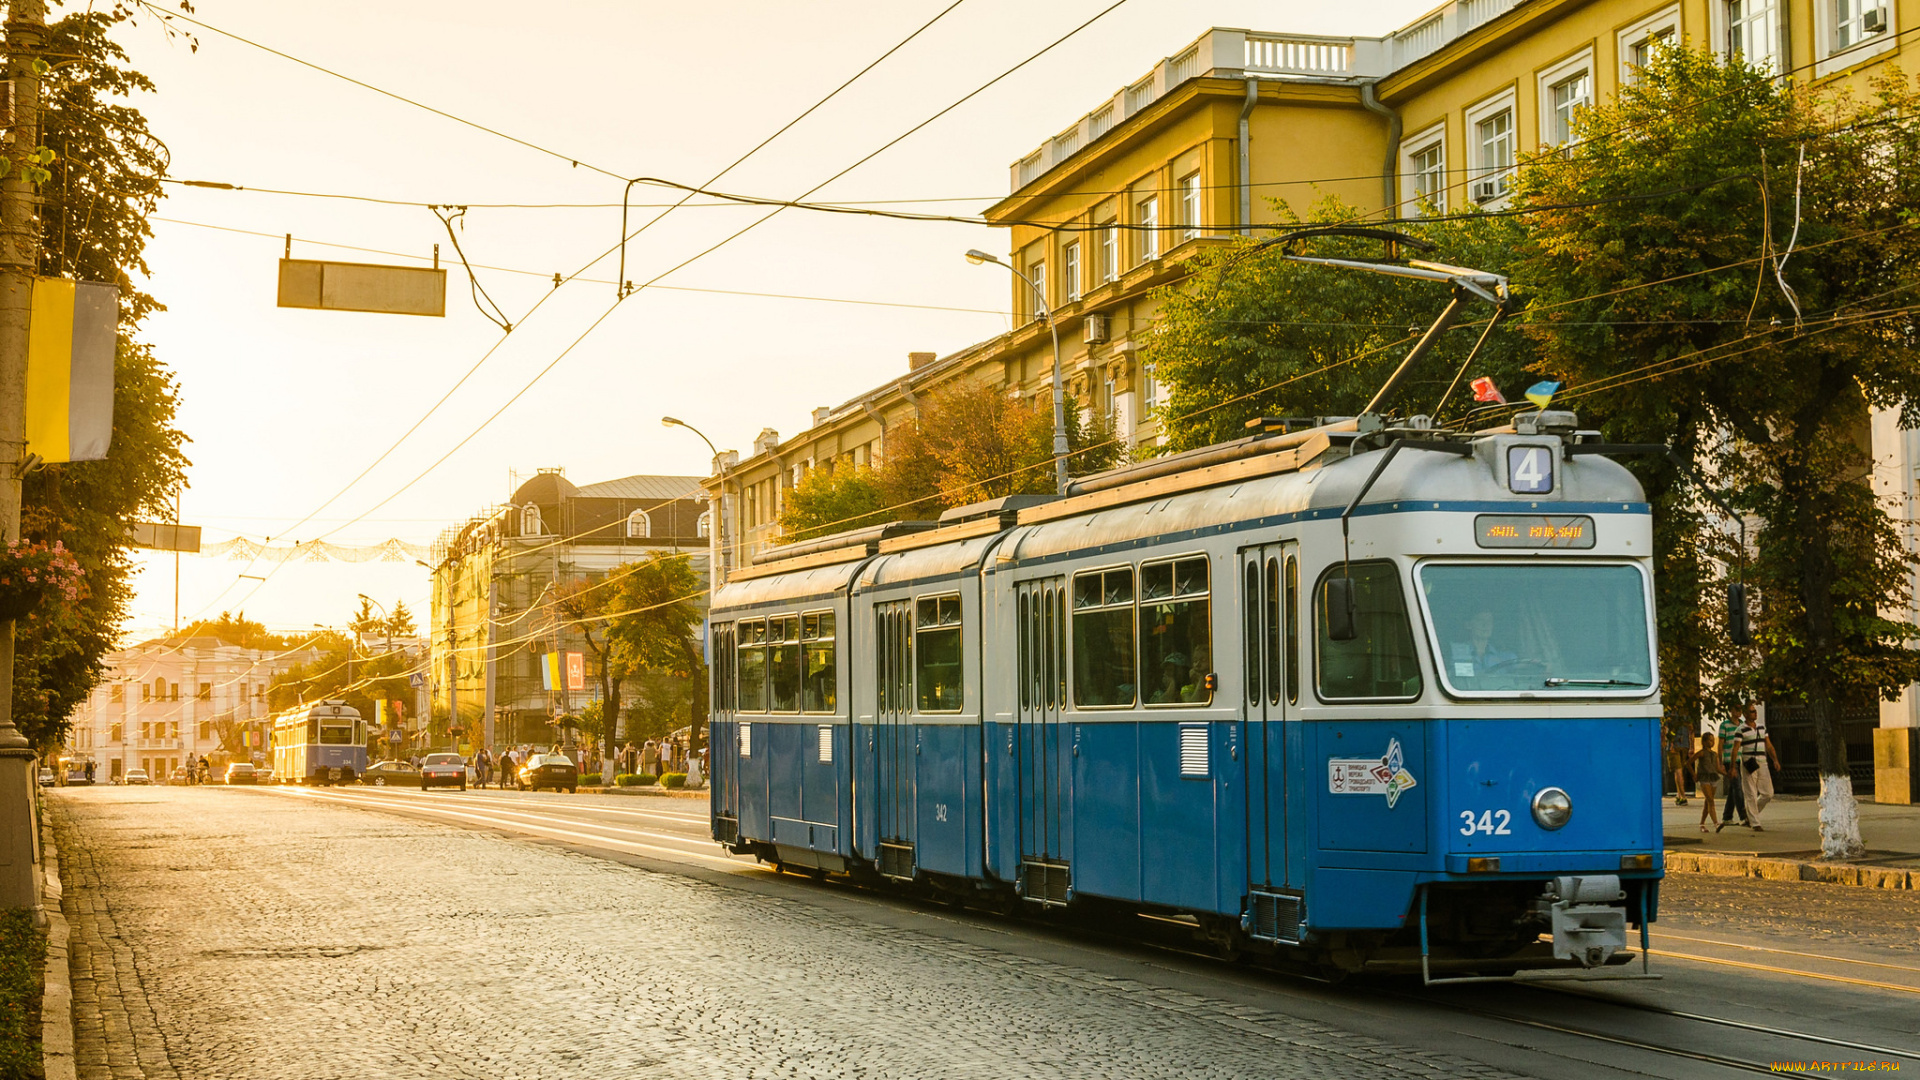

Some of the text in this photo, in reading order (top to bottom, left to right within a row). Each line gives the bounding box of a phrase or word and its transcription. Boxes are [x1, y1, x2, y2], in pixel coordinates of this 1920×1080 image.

[1514, 447, 1543, 489] 4
[935, 803, 947, 822] 342
[1460, 809, 1512, 836] 342
